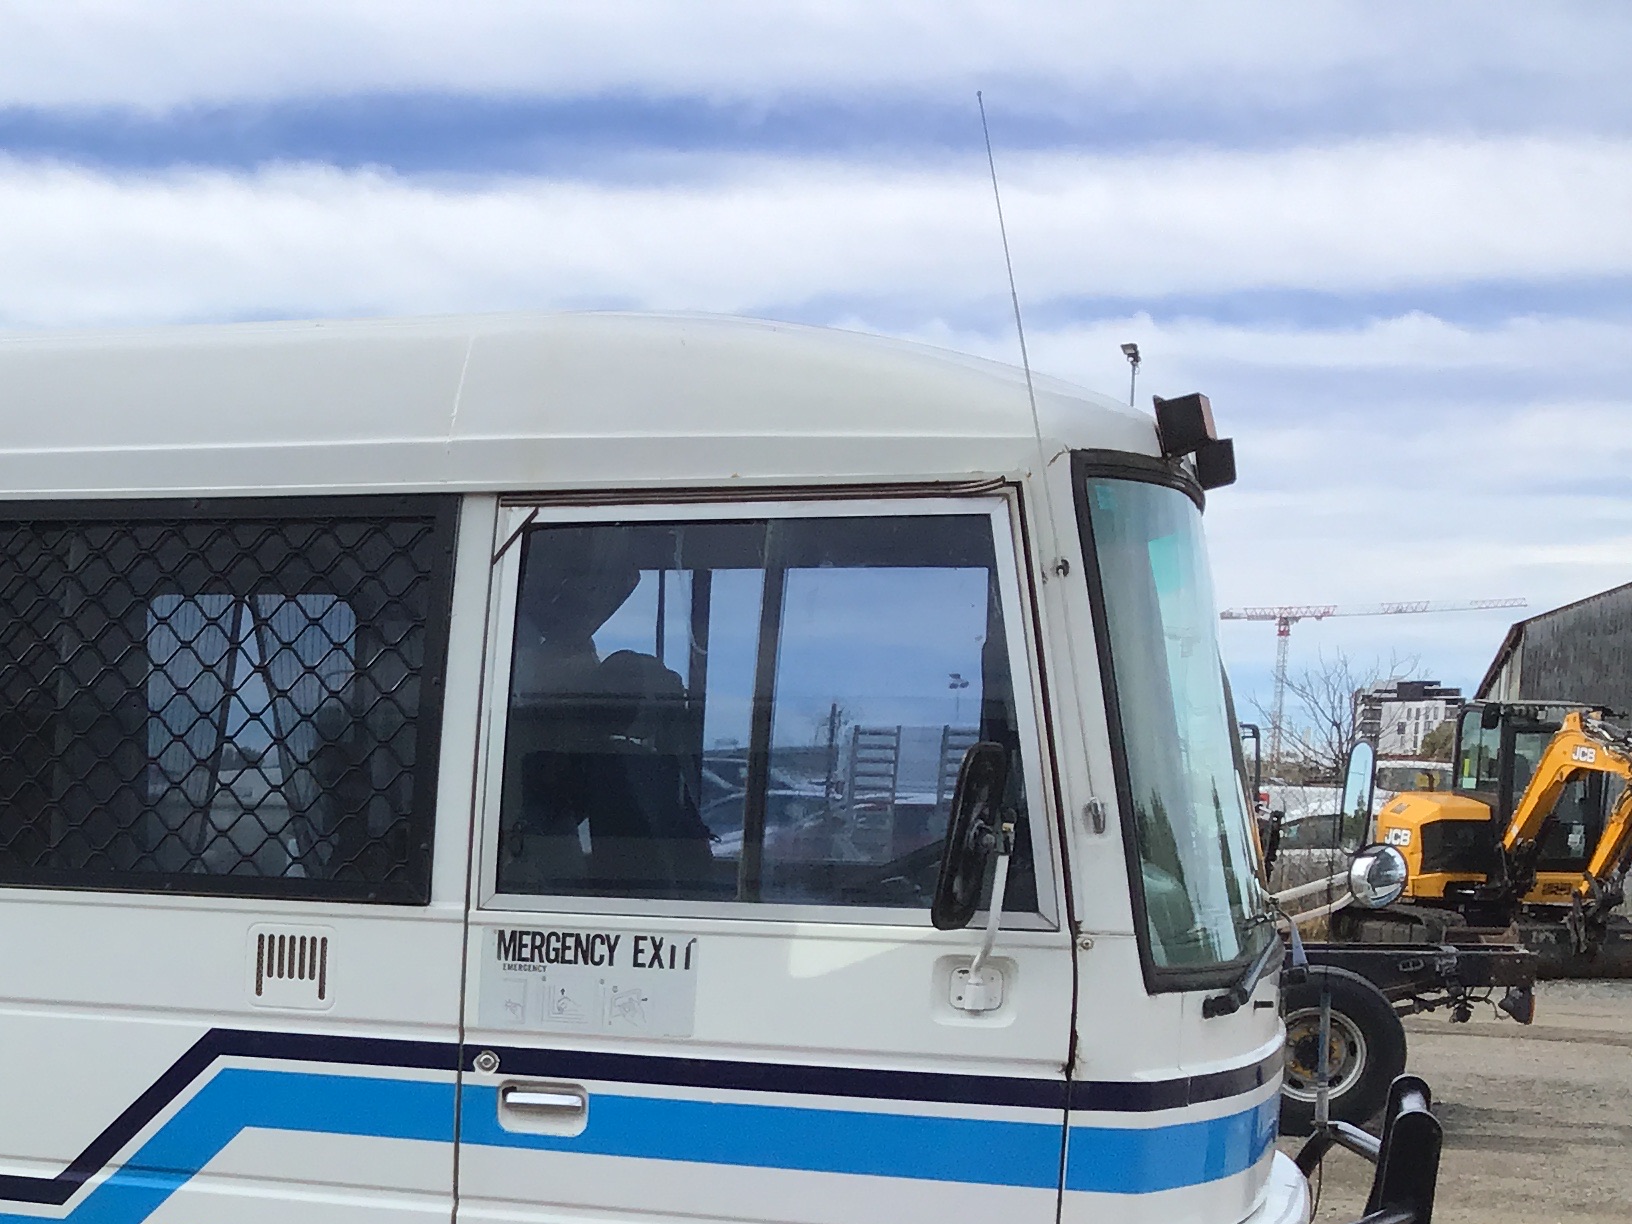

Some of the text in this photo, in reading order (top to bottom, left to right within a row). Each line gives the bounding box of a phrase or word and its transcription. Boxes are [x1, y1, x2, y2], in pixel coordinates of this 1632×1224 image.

[1572, 746, 1596, 762] JCB
[1384, 828, 1412, 846] JCB
[502, 963, 547, 973] EMERGENCY
